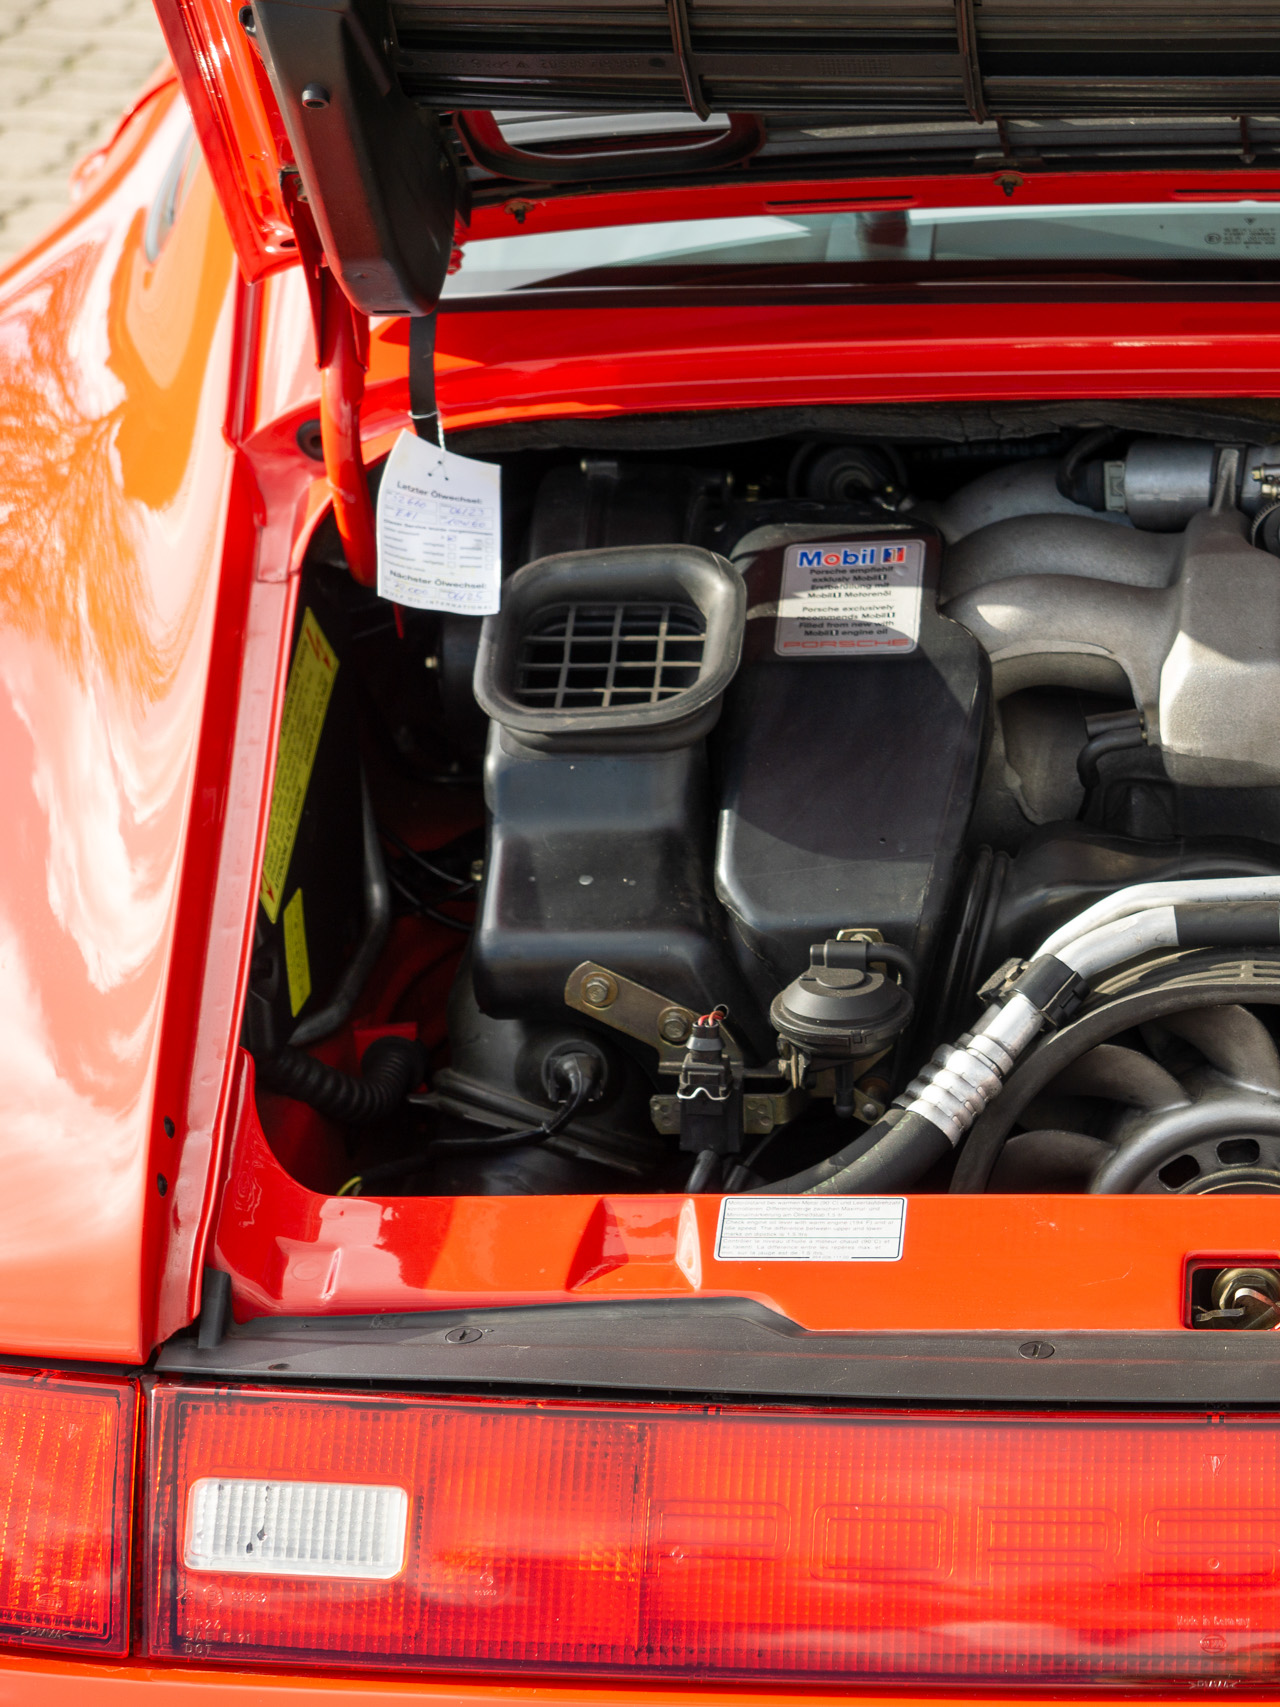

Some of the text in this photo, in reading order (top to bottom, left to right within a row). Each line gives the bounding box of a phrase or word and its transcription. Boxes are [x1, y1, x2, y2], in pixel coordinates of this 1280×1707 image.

[798, 548, 876, 567] Mobil
[809, 566, 894, 576] Porsche empfiehlt
[844, 590, 892, 598] Motorenöl
[802, 604, 895, 613] Porsche exclusively
[783, 638, 909, 649] PORSCHE
[184, 1643, 214, 1655] DOT
